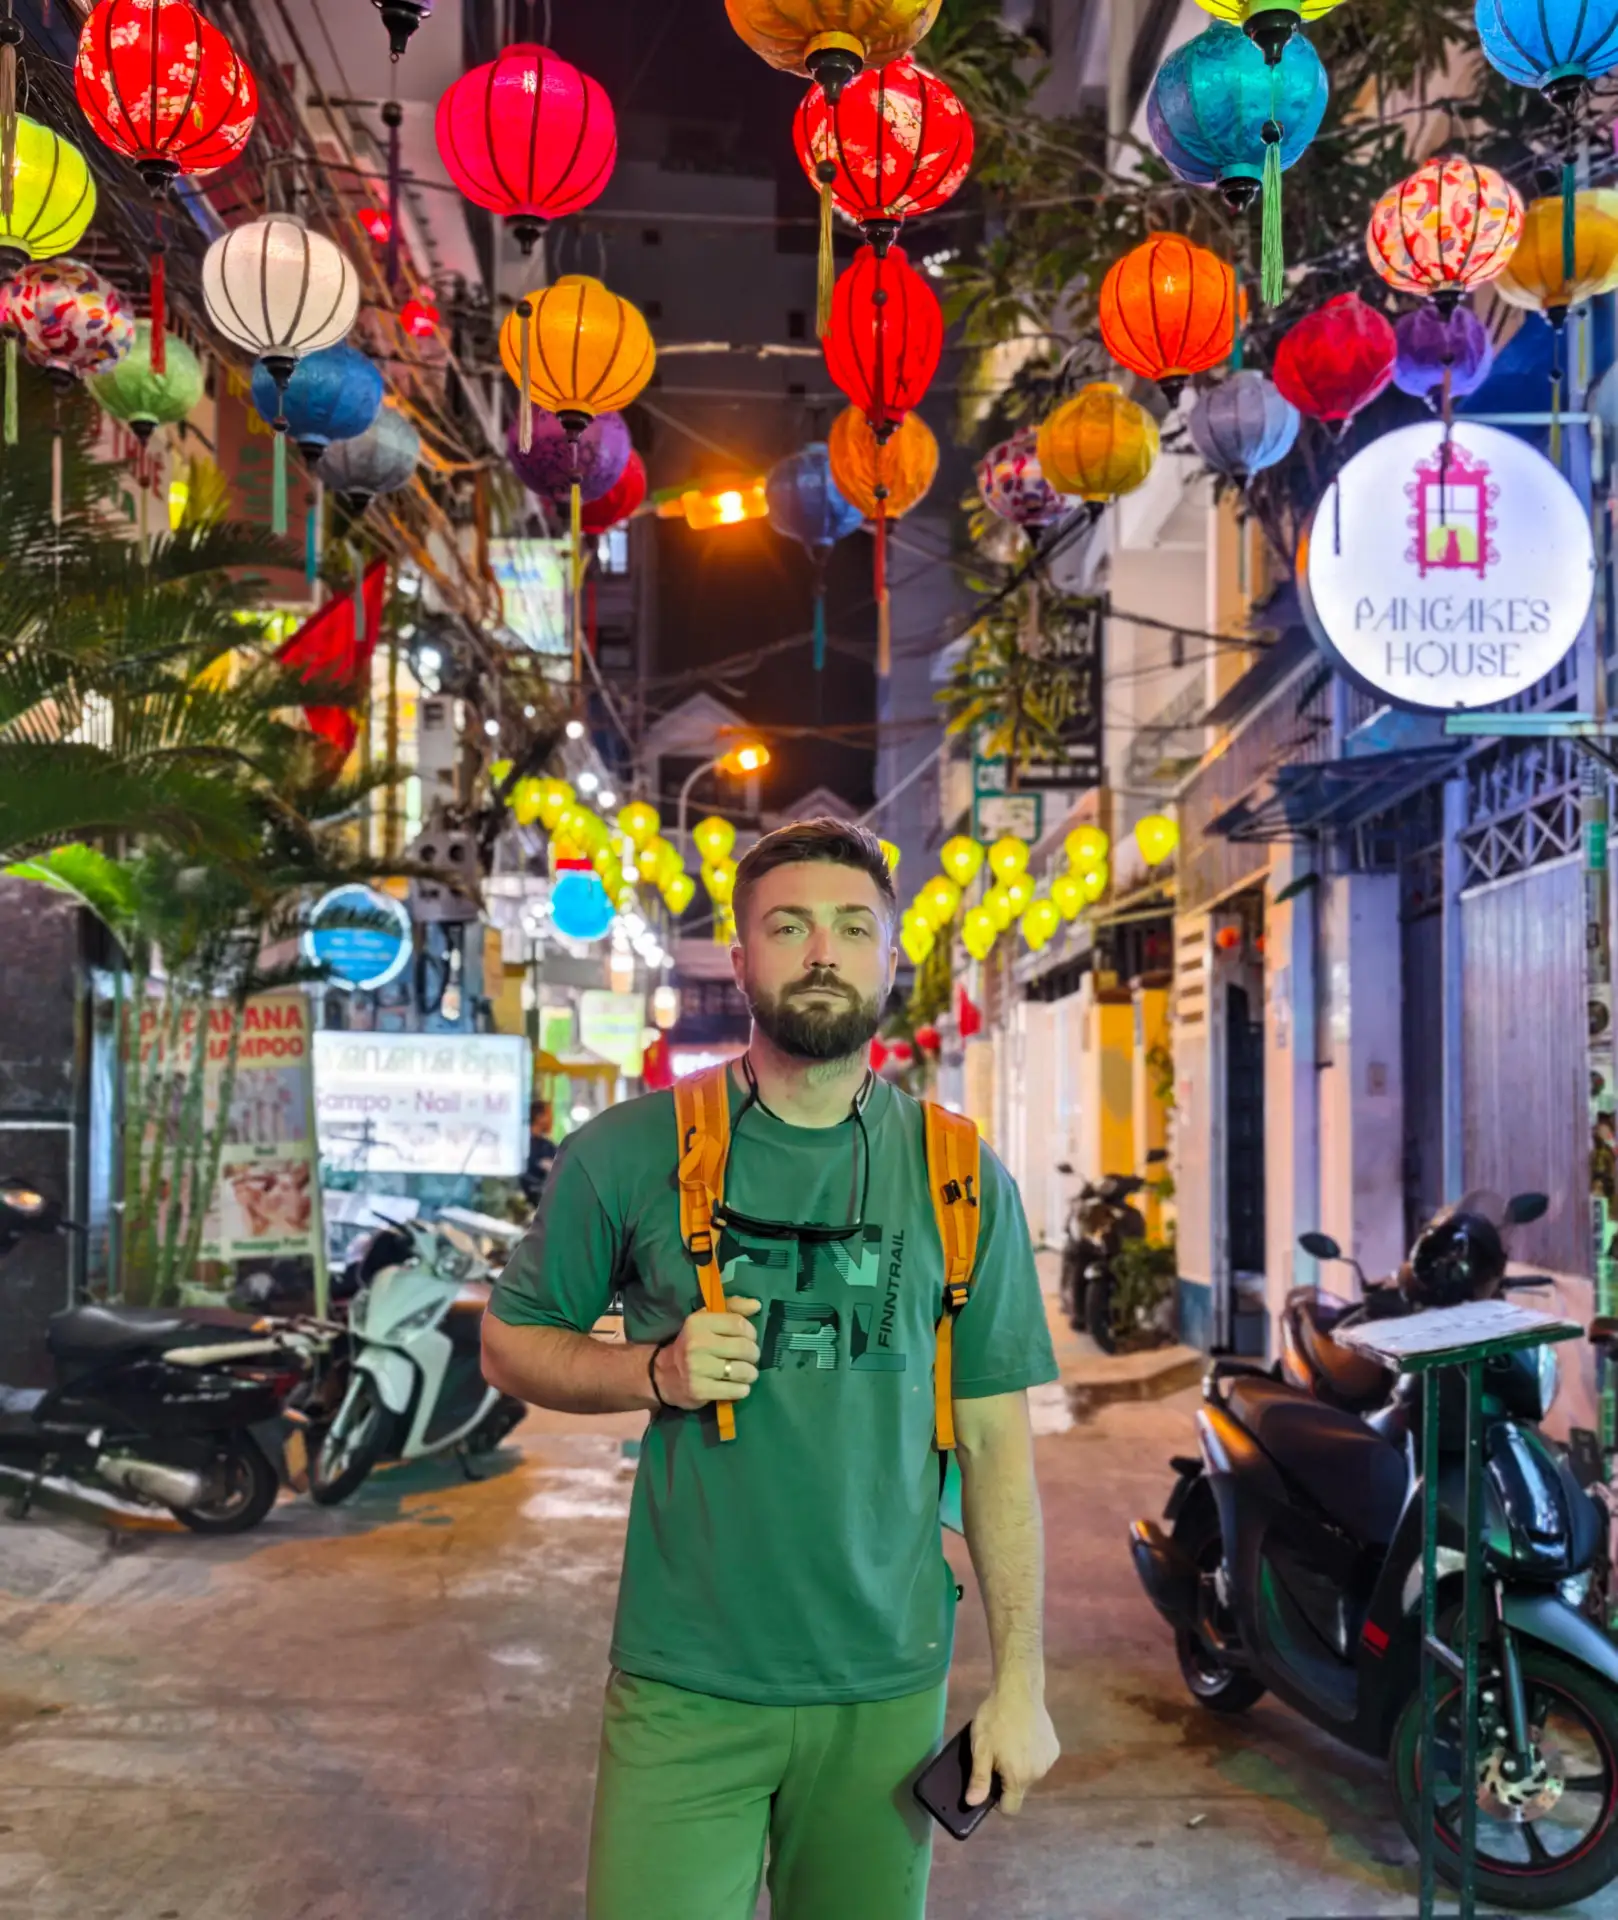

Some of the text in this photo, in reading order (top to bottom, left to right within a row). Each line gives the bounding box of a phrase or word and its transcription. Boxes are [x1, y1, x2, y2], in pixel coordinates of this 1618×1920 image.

[1354, 596, 1552, 634] PANCAKES
[1385, 640, 1522, 678] HOUSE
[877, 1228, 906, 1349] FINNTRAIL
